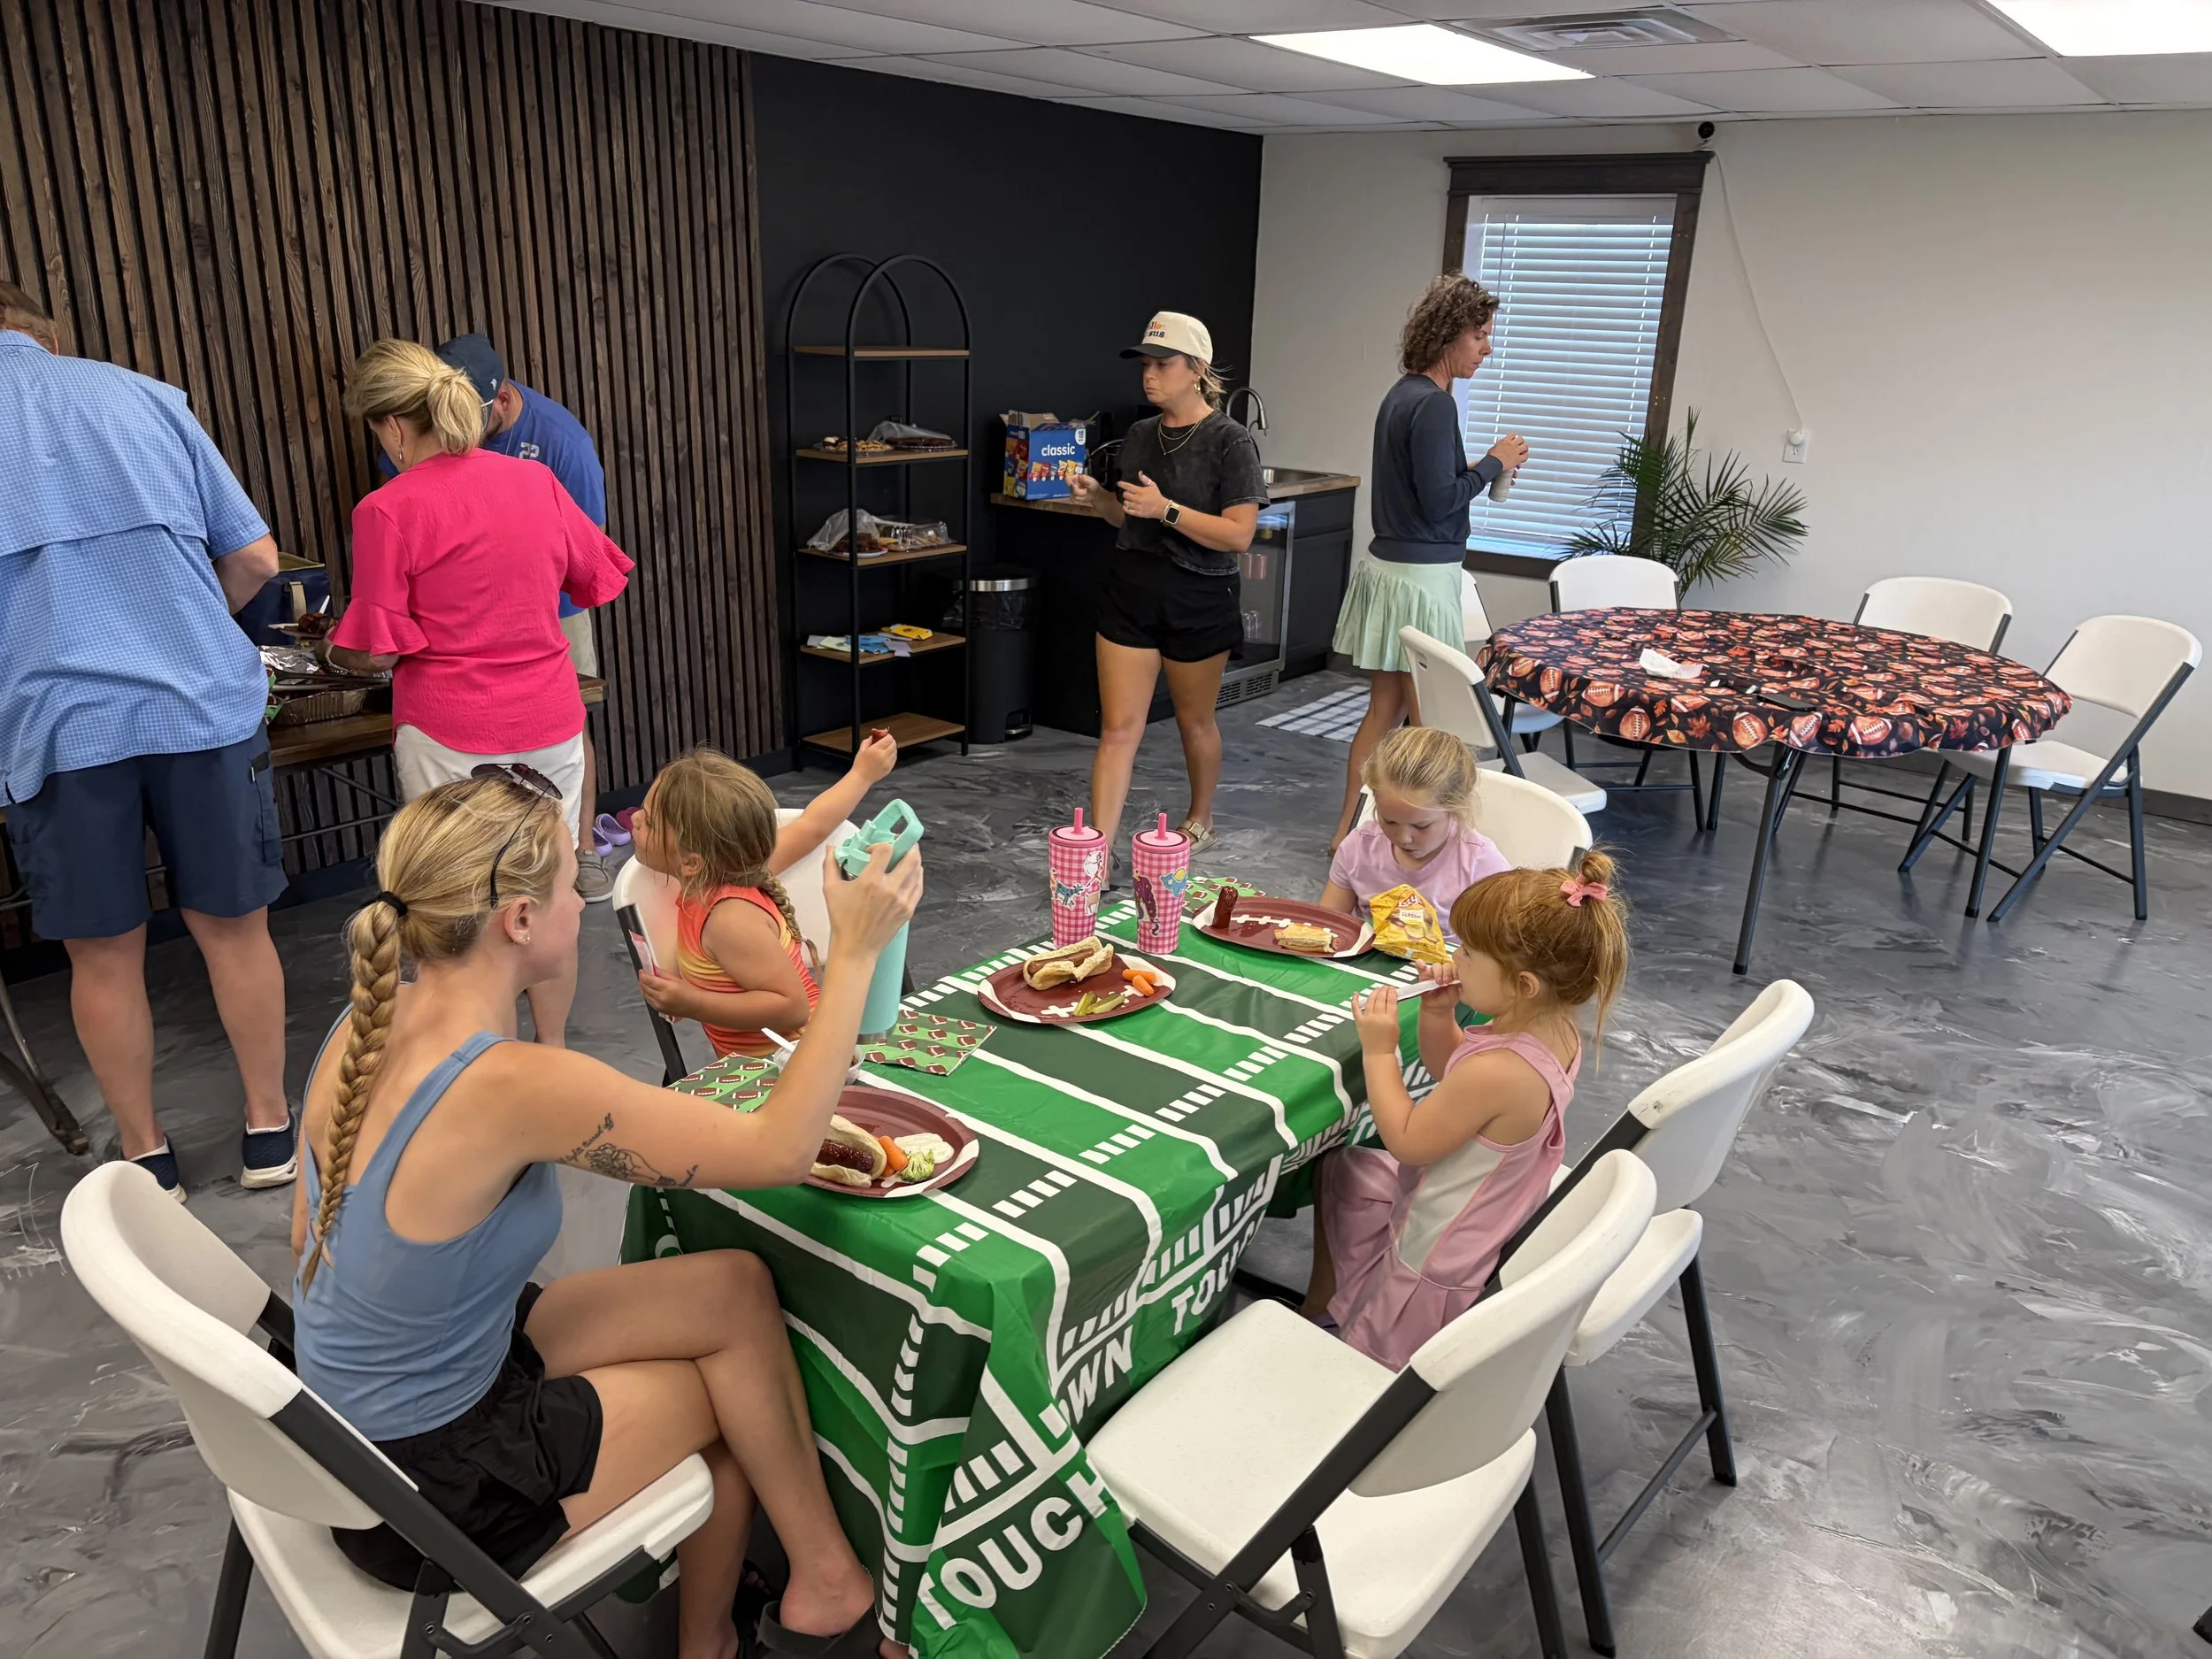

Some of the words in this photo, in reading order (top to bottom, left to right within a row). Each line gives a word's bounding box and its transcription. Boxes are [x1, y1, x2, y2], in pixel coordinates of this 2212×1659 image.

[1041, 442, 1076, 457] classic
[918, 1452, 1111, 1630] TOUCH
[1058, 1324, 1133, 1427] WN
